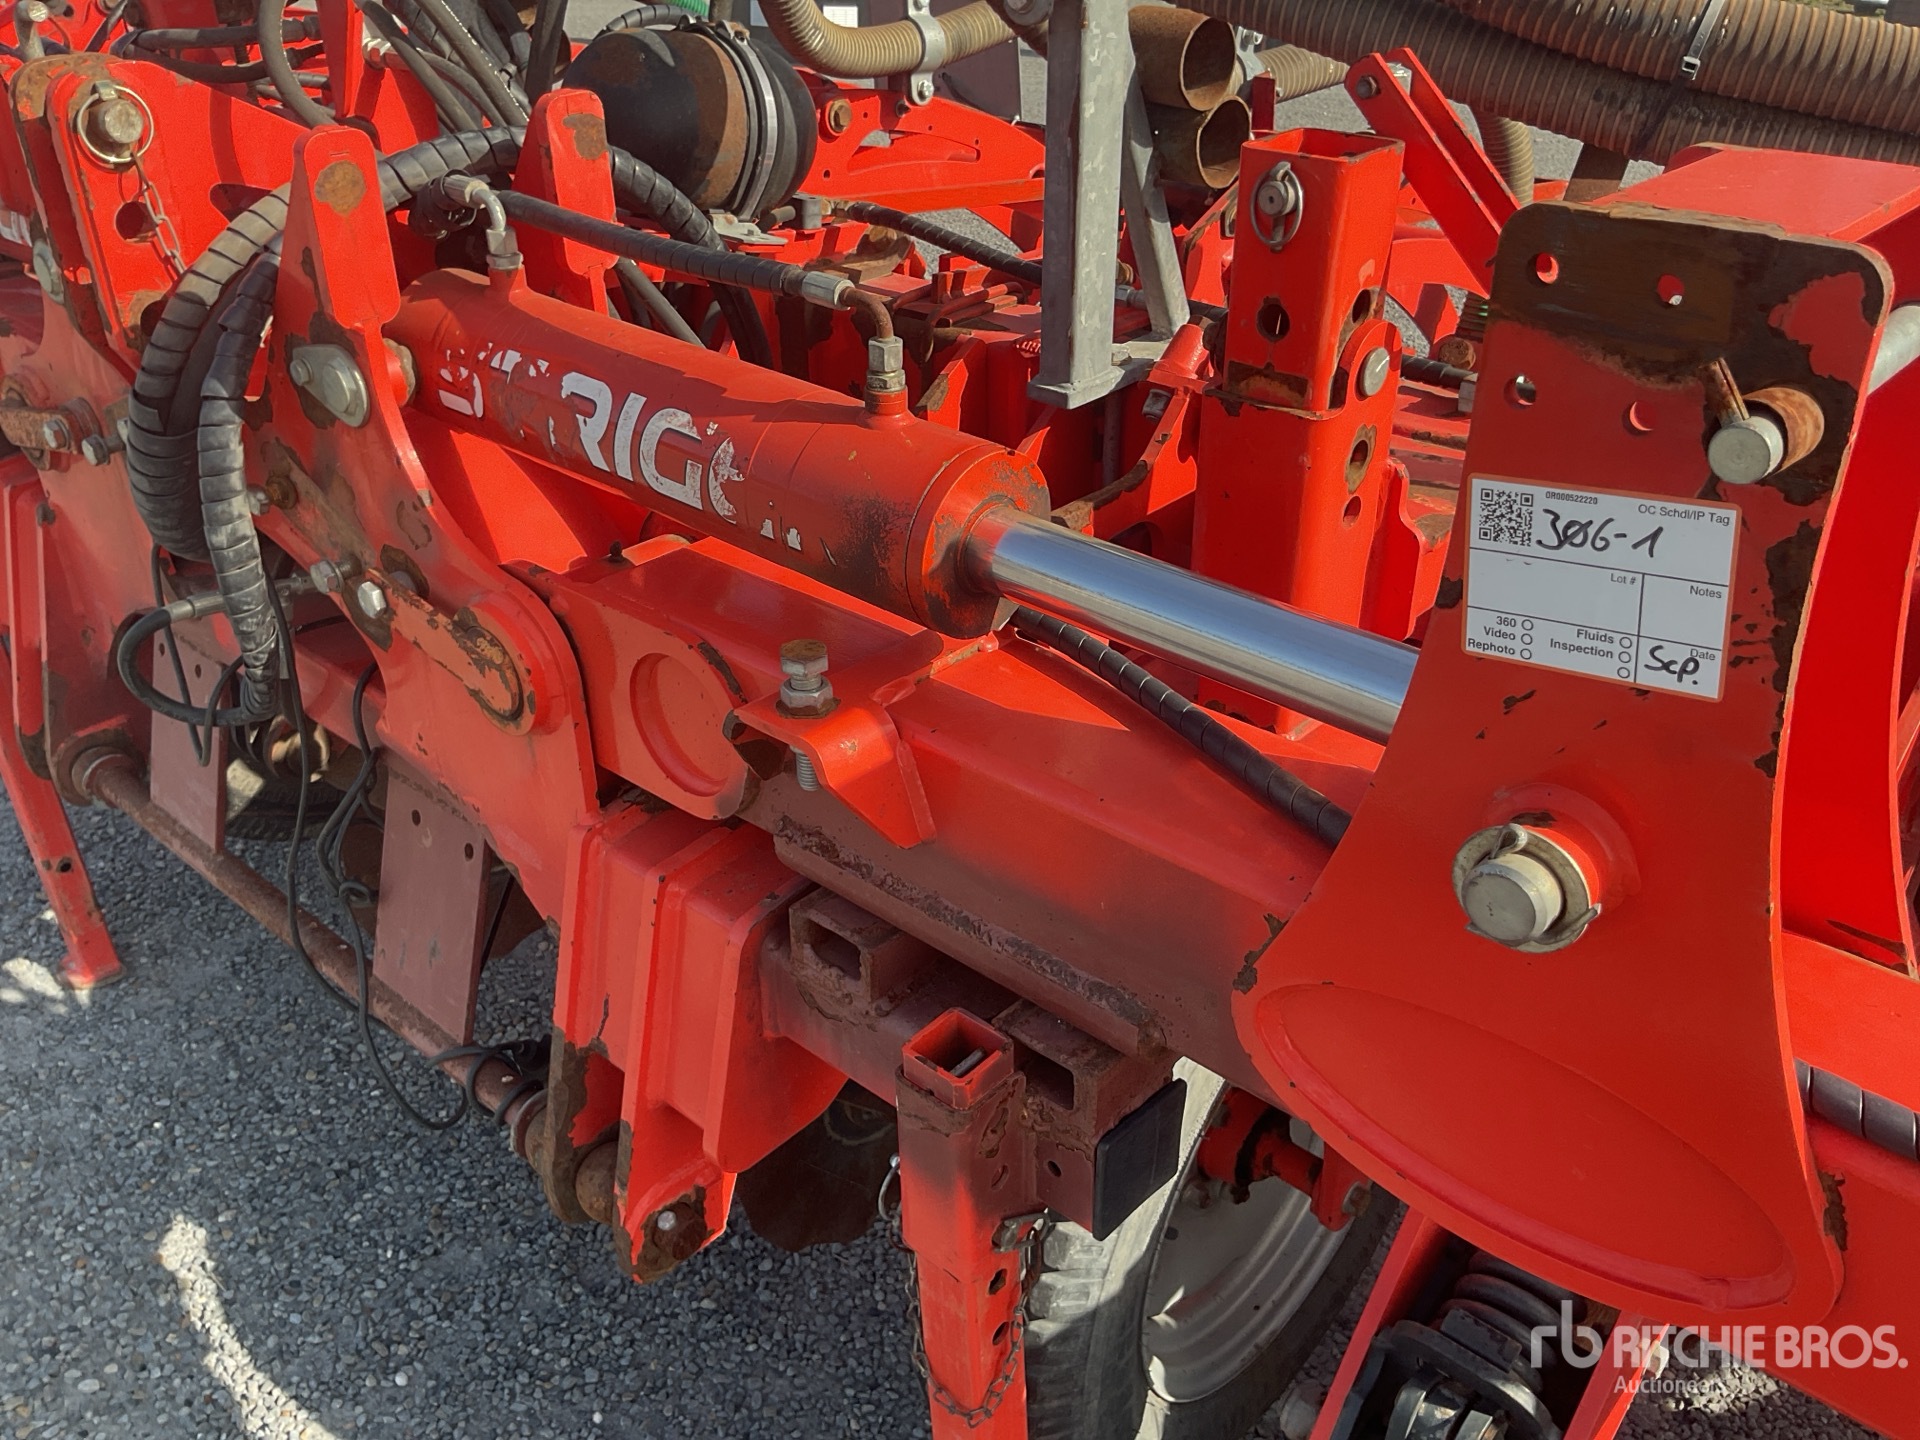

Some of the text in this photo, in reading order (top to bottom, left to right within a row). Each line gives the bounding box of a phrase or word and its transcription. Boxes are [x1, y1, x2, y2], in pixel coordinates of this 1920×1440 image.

[1637, 503, 1656, 516] OC
[1708, 512, 1730, 527] Tag
[1610, 573, 1637, 585] Lot #
[1690, 585, 1722, 599] Notes
[1496, 616, 1517, 628] 360
[1483, 626, 1516, 641] Video
[1576, 629, 1614, 644] Fluids
[1467, 637, 1516, 656] Rephoto
[1550, 638, 1614, 659] Inspection
[1690, 648, 1716, 661] Date
